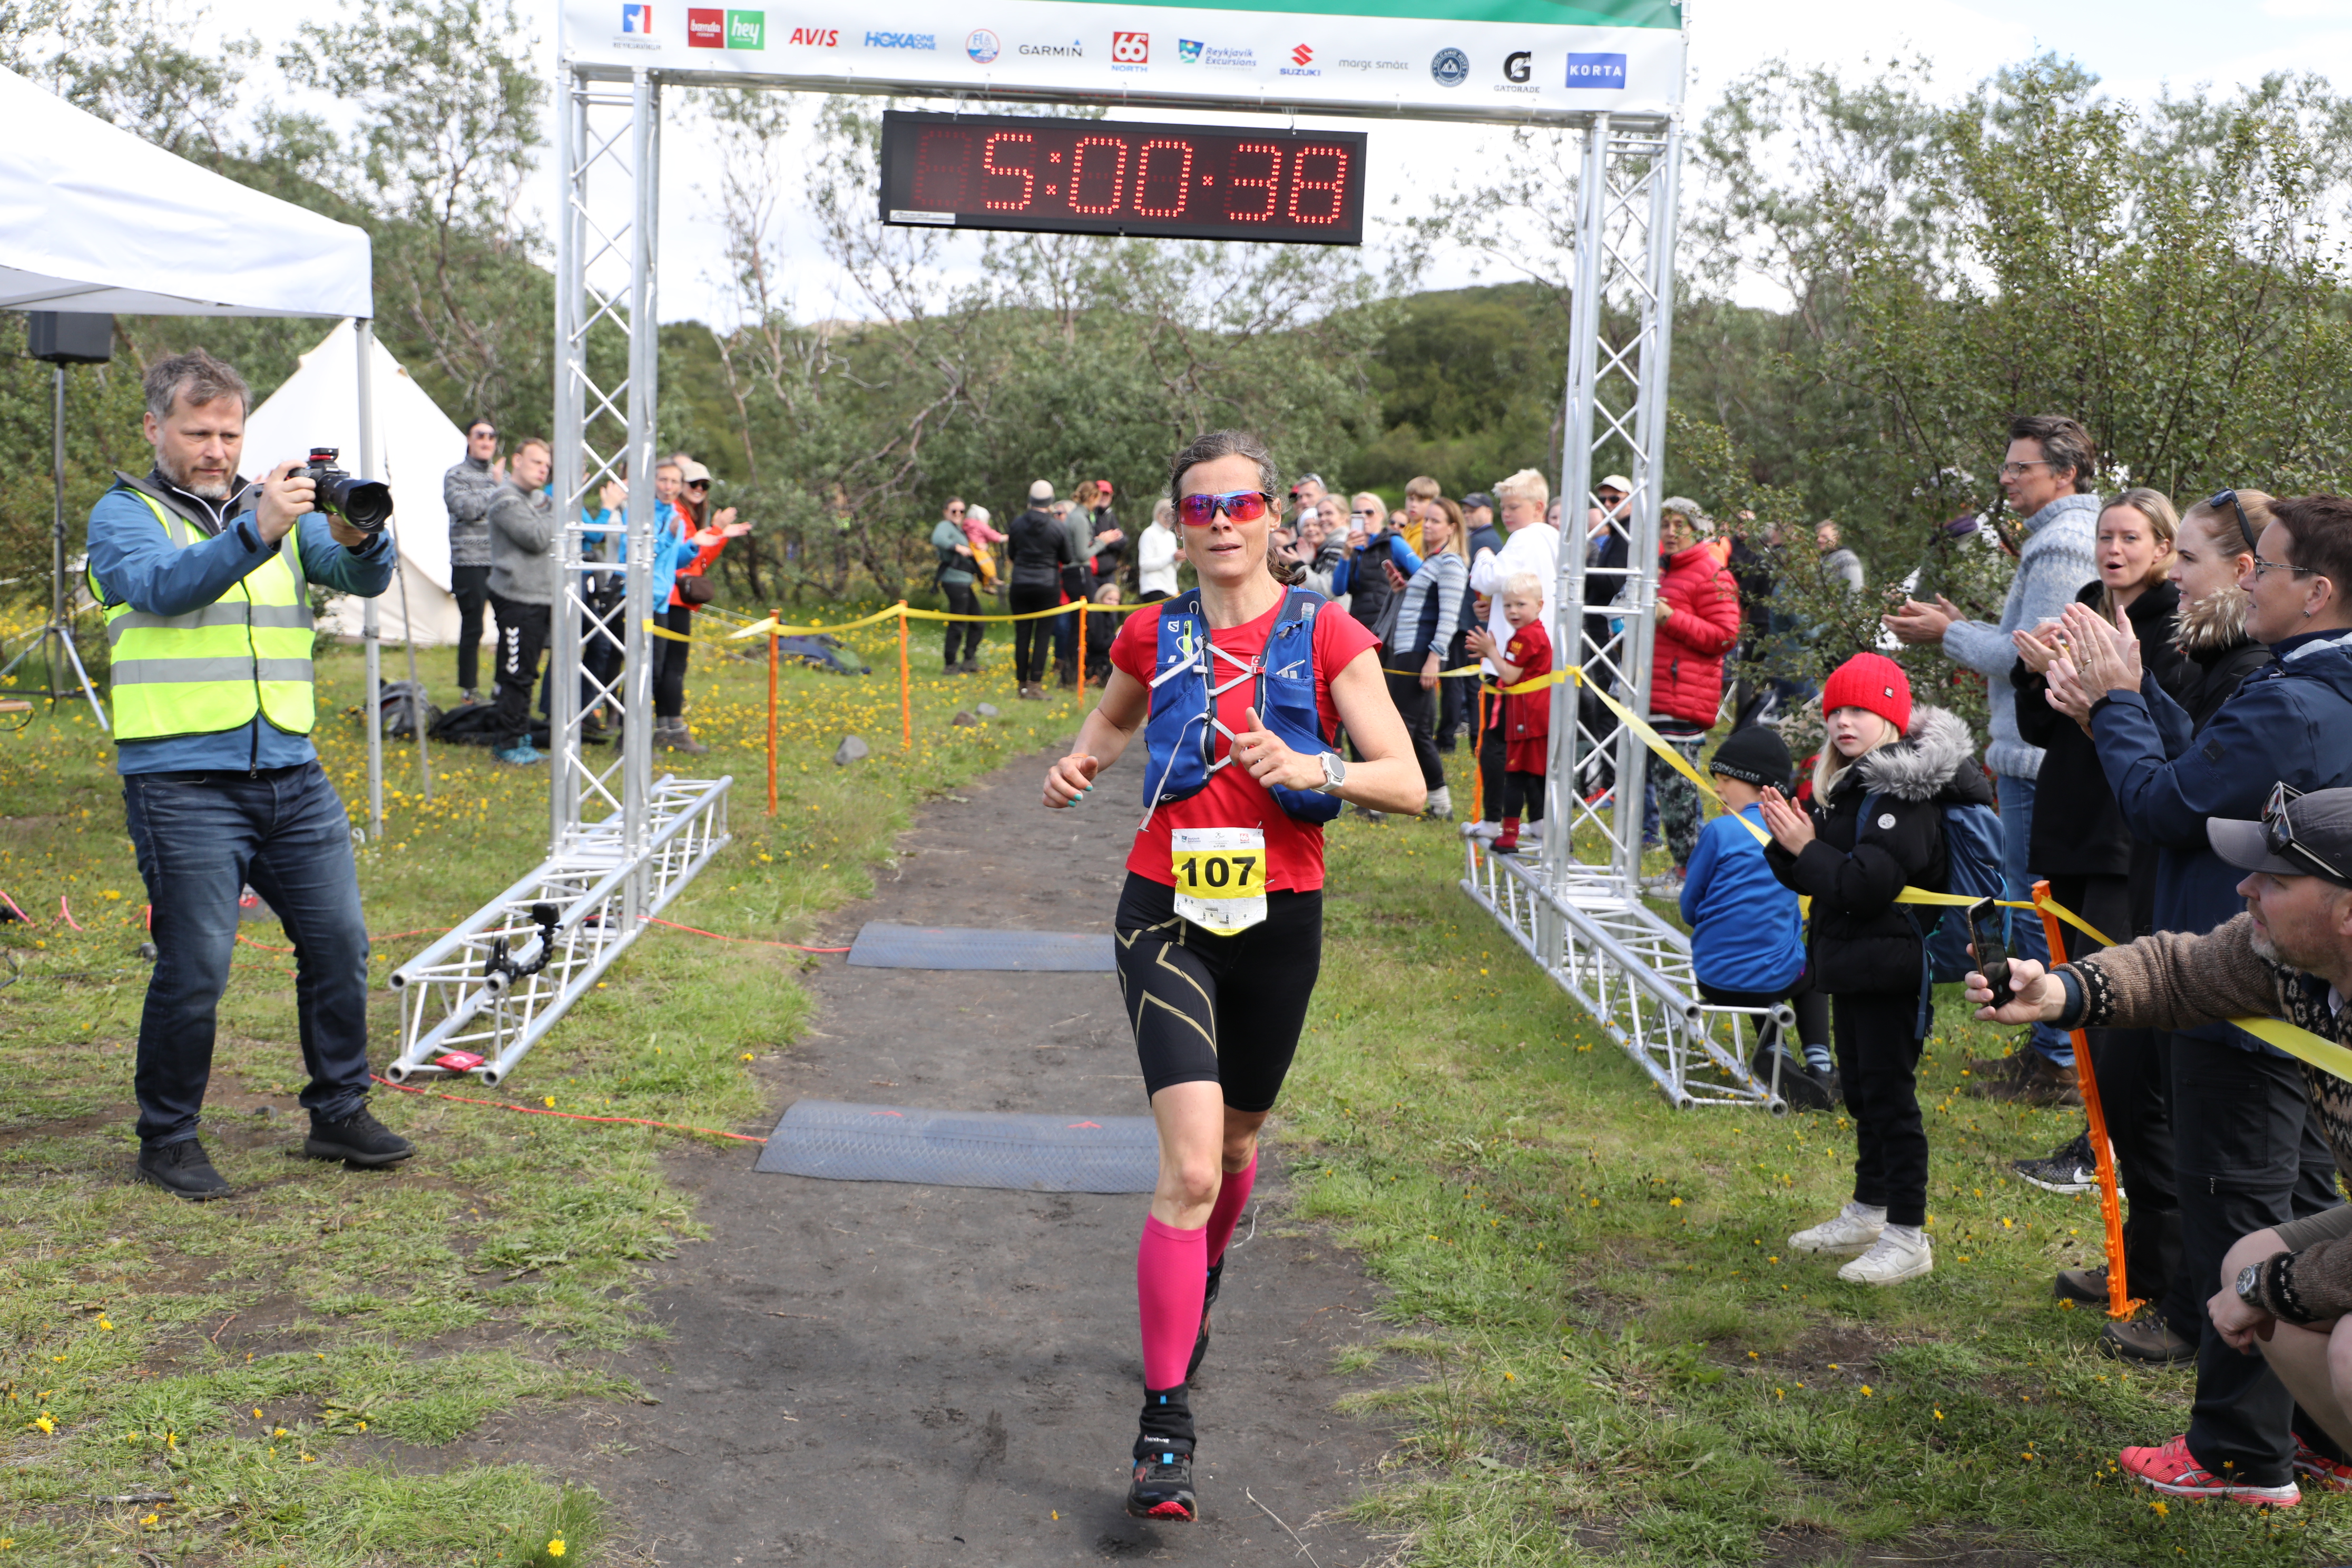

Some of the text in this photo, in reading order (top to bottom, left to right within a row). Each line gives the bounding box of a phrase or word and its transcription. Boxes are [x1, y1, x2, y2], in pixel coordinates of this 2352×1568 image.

[731, 15, 760, 45] hey
[789, 28, 839, 47] AVIS
[864, 32, 915, 49] HOKA
[914, 34, 935, 42] ONE
[1018, 44, 1083, 57] GARMIN
[1206, 47, 1253, 58] Reykjavik
[1206, 56, 1257, 66] Excursions
[1433, 51, 1457, 68] VOLCANO
[1279, 68, 1321, 76] SUZUKI
[1570, 65, 1623, 77] KORTA
[1494, 85, 1541, 93] GATORADE
[1180, 856, 1256, 887] 107
